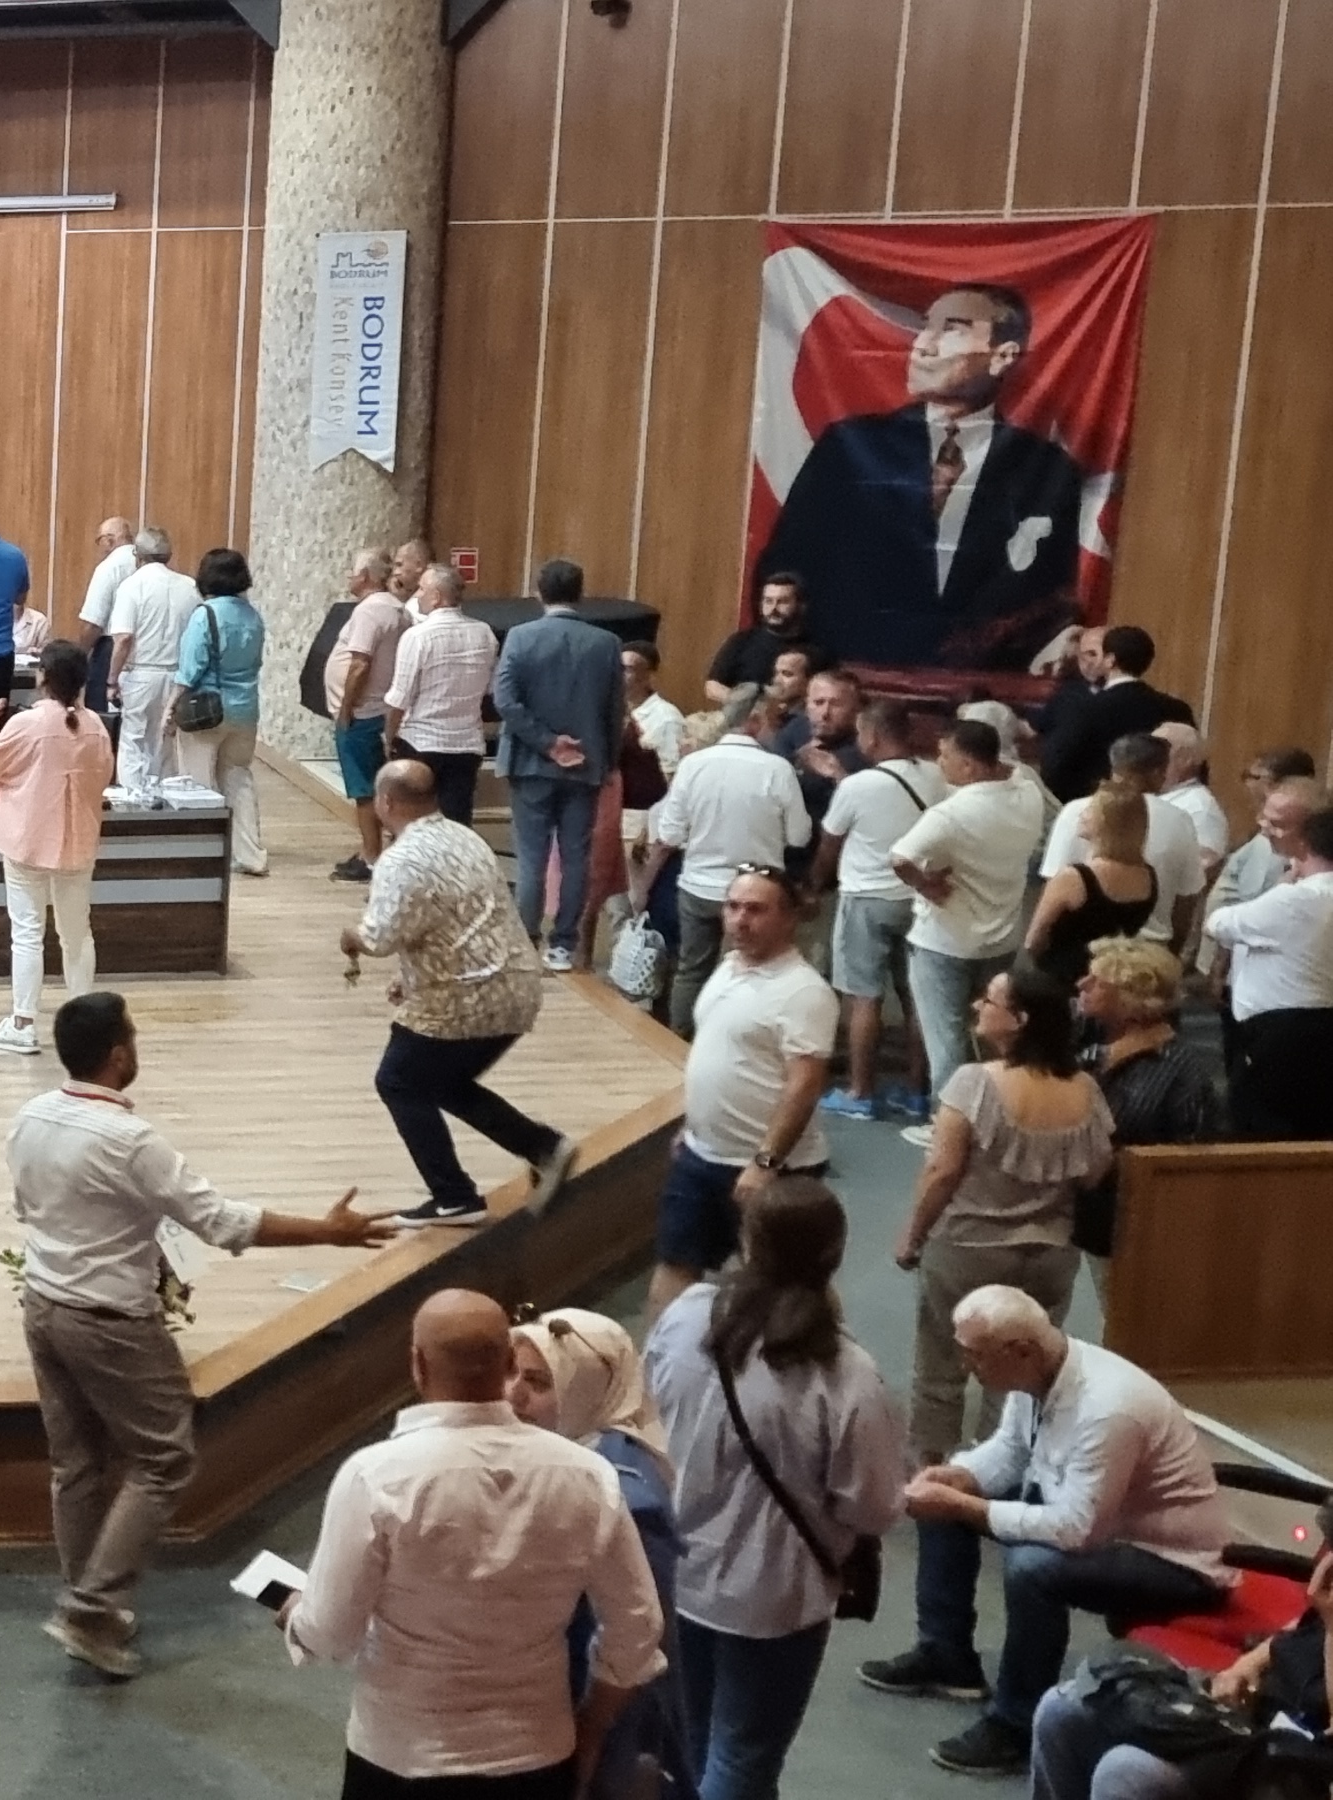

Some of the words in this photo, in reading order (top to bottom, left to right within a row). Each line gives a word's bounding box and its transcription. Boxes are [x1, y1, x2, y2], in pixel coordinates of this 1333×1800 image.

[330, 270, 388, 279] BODRUM
[332, 297, 354, 342] Kent
[357, 296, 385, 435] BODRUM
